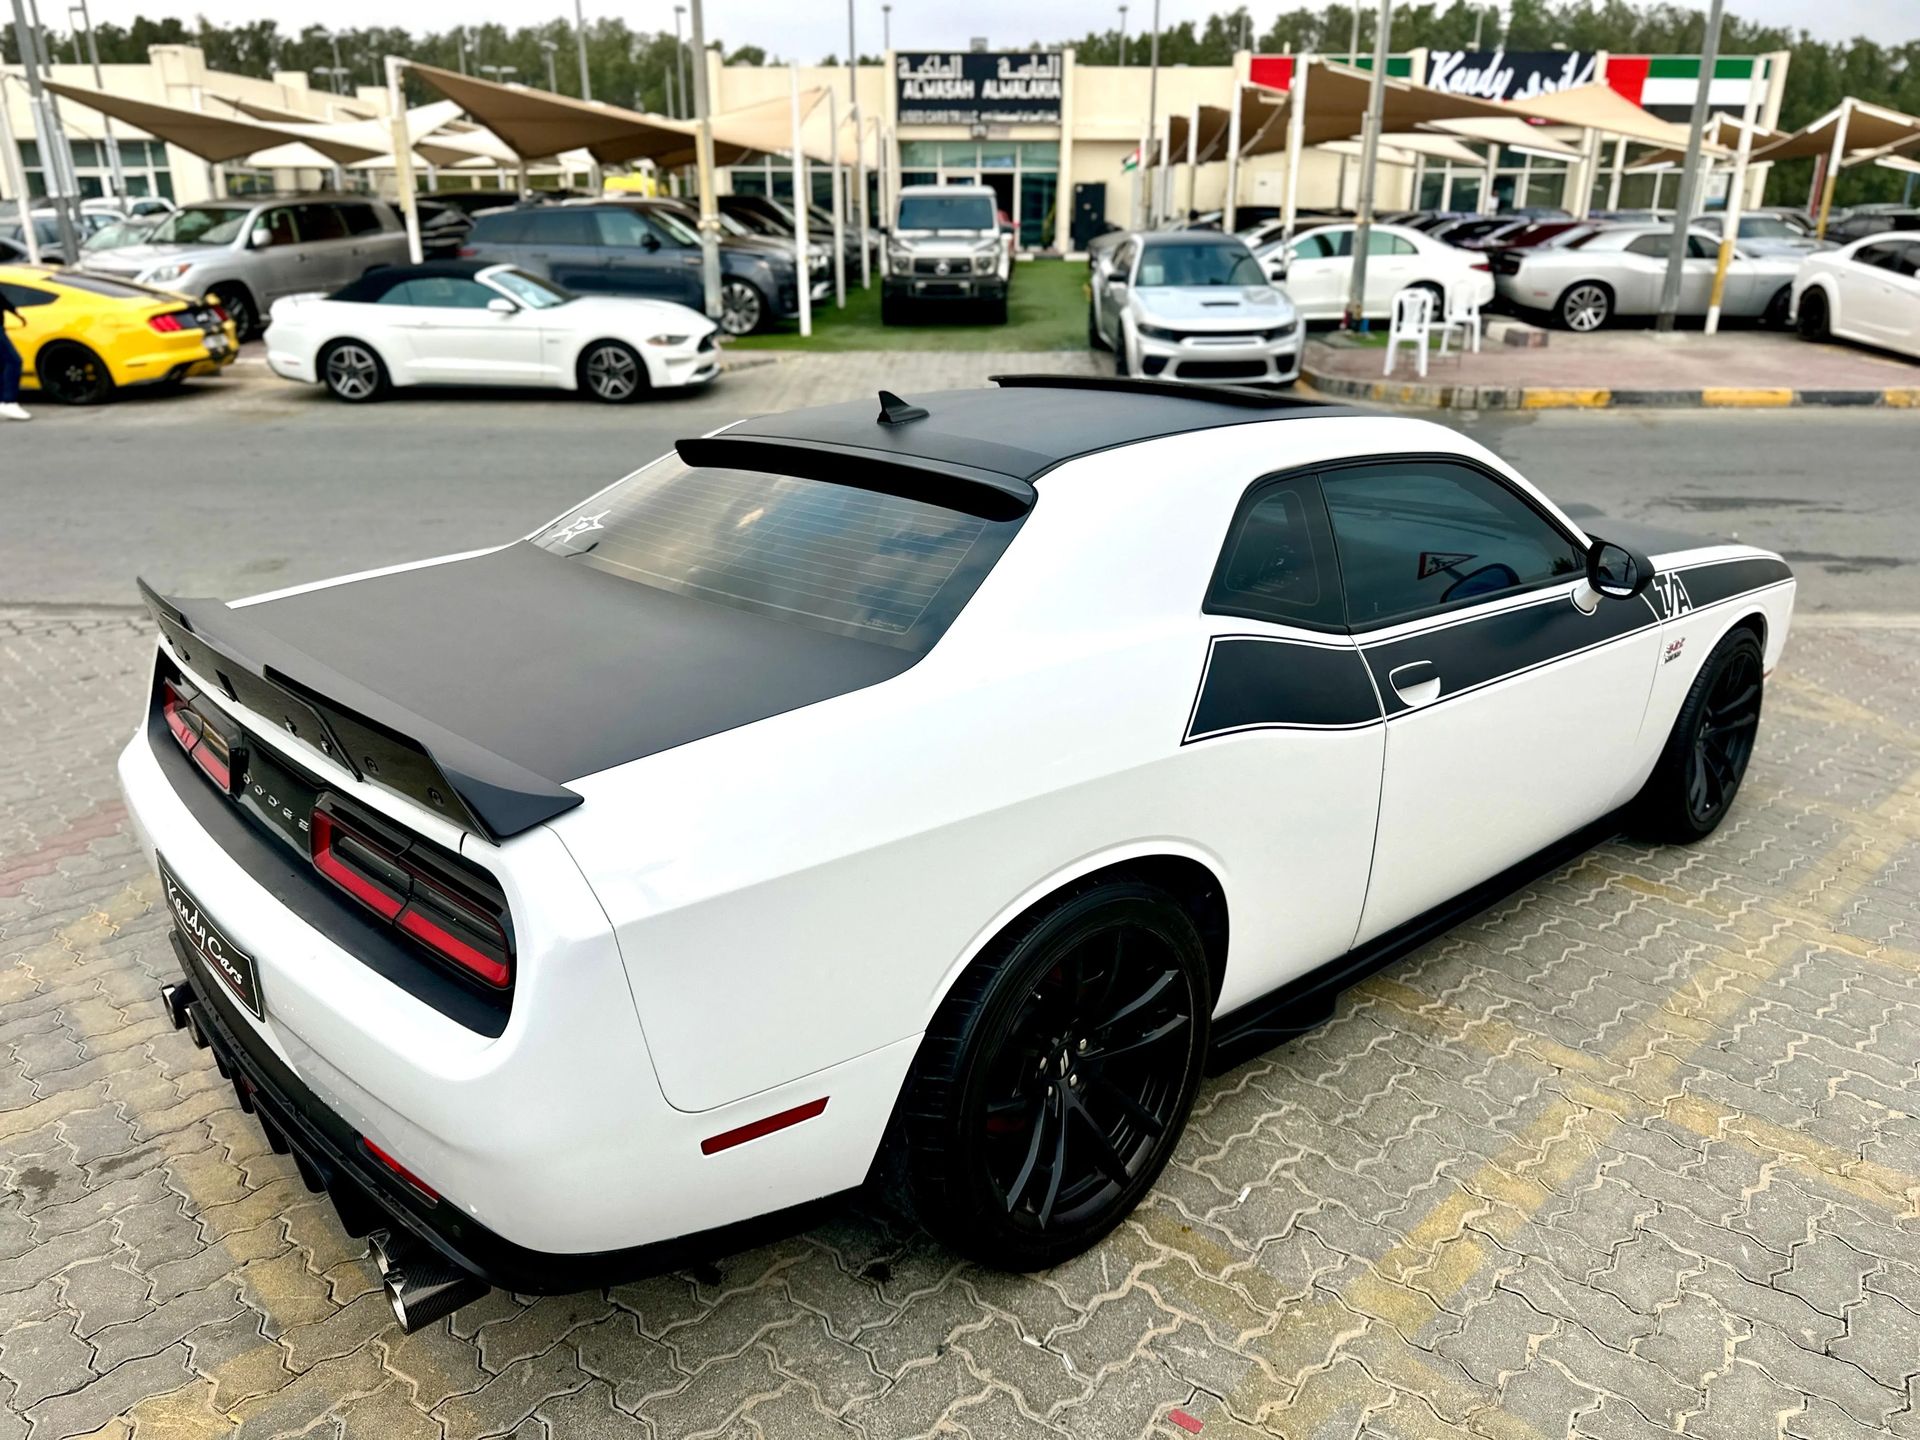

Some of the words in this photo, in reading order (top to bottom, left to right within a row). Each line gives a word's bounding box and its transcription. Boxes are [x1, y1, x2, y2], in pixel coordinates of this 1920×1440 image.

[1429, 50, 1514, 102] Kandy
[242, 772, 309, 832] DODGE
[163, 873, 206, 950] Kandy
[207, 936, 243, 985] Cars
